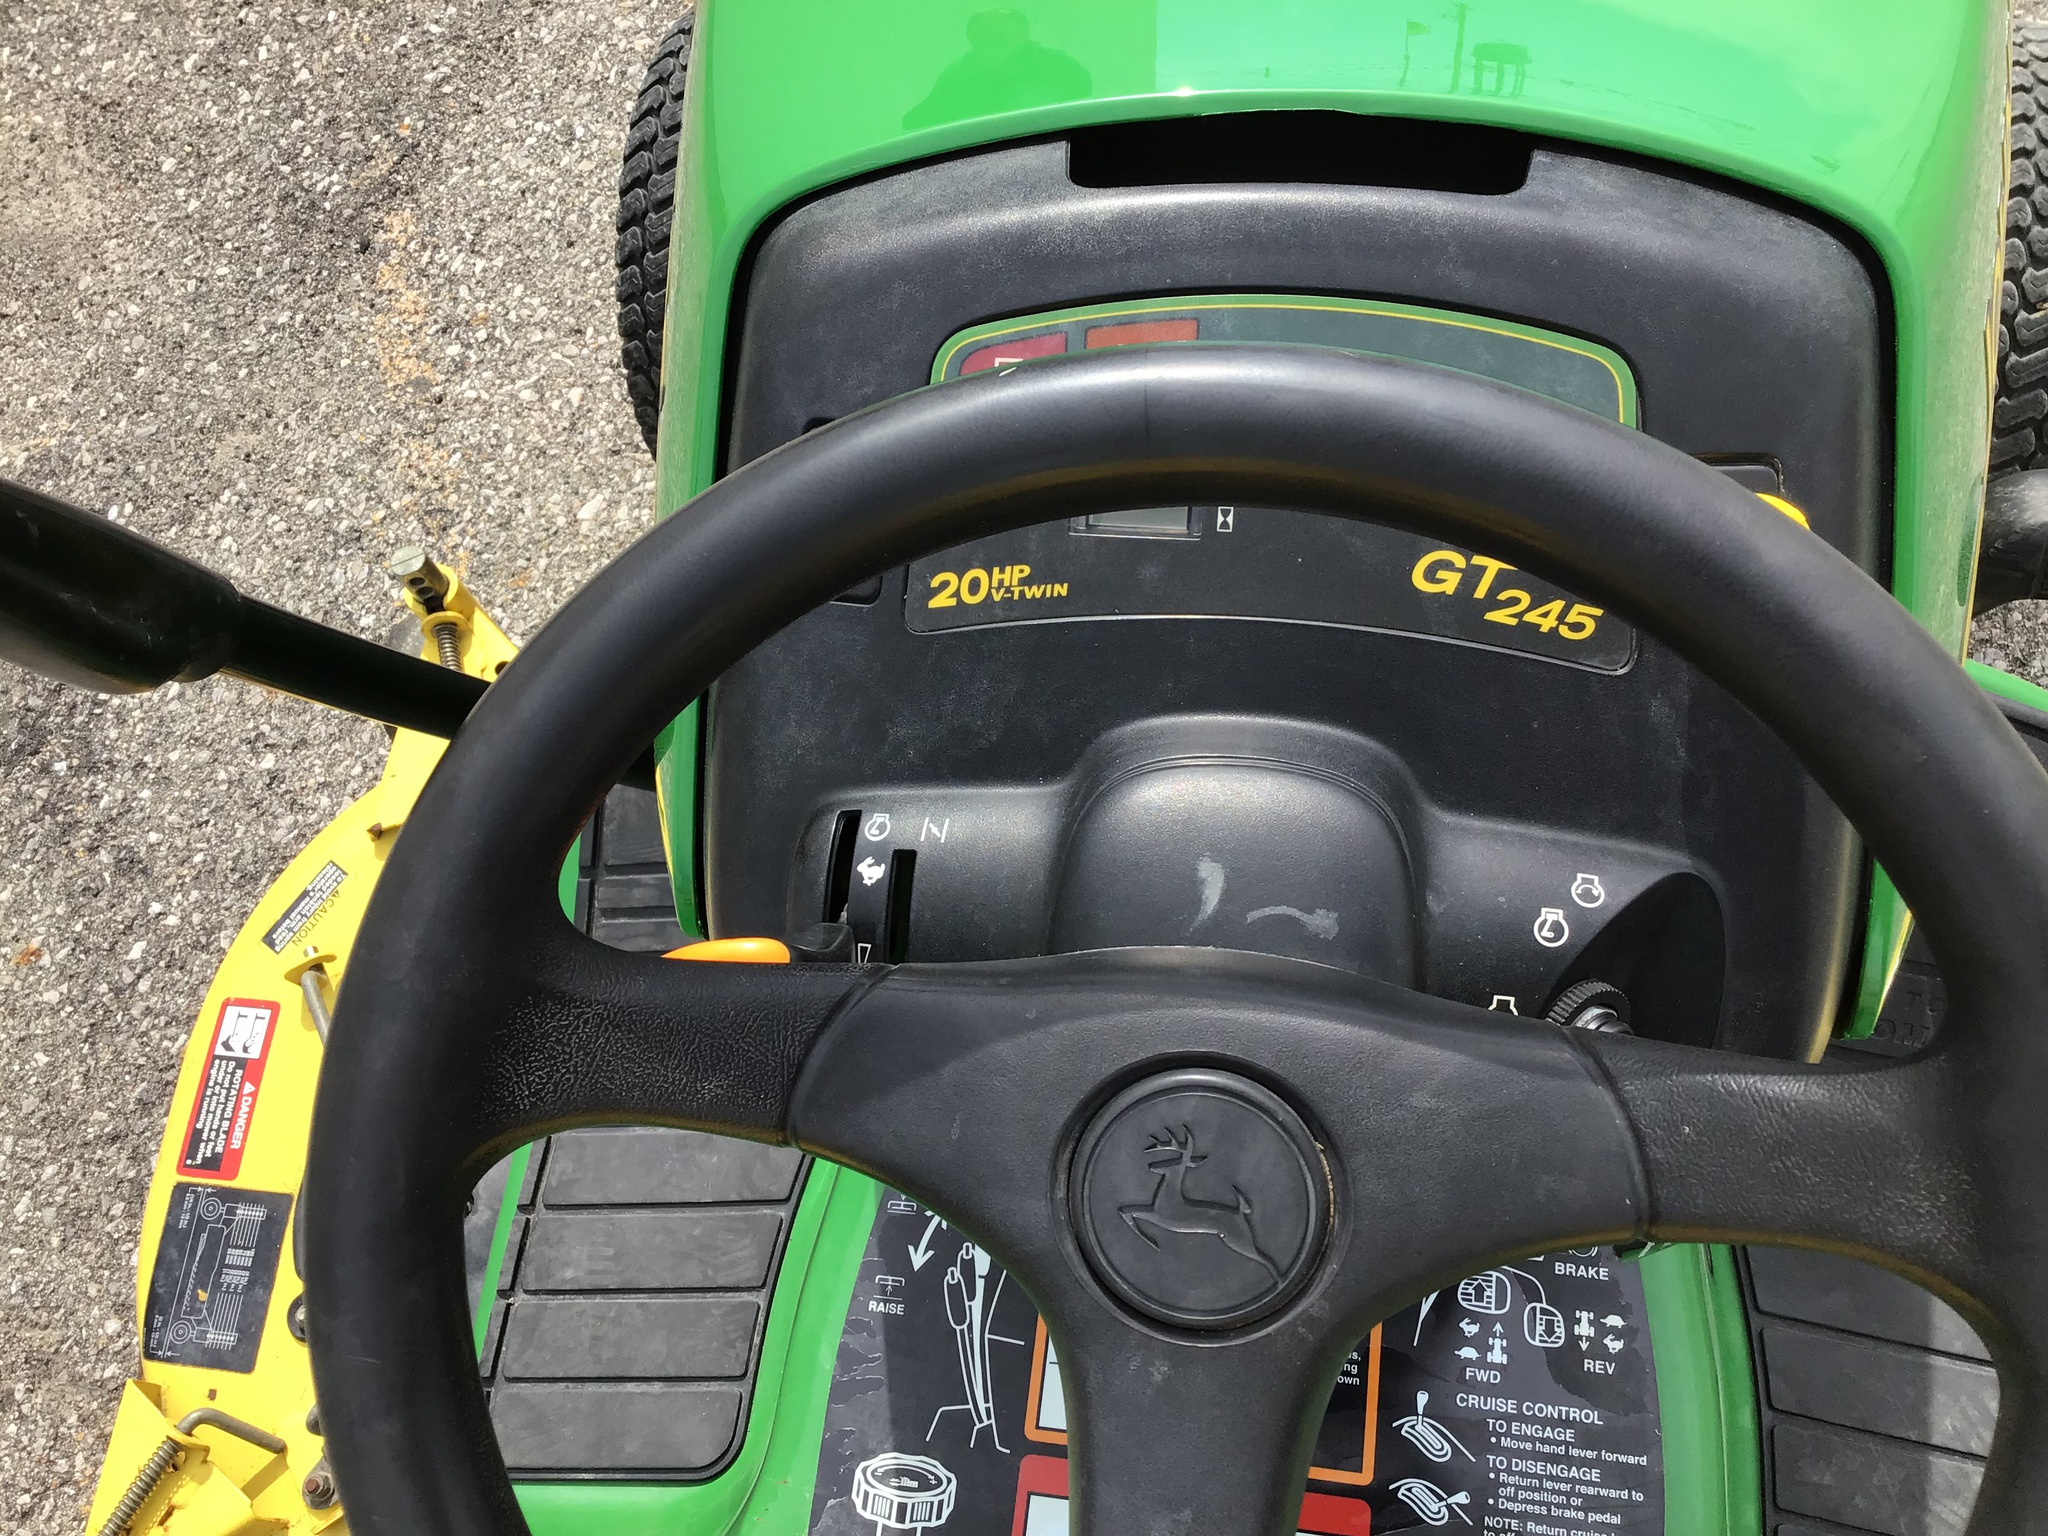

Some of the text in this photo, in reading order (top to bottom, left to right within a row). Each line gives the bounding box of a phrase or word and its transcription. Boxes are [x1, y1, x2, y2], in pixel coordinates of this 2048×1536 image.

[928, 564, 1031, 609] 20 HP
[990, 582, 1069, 602] V-TWIN
[1411, 550, 1604, 640] GT 245
[321, 868, 341, 891] loaded
[335, 872, 346, 882] To
[320, 880, 338, 899] avoid
[289, 895, 311, 919] manual
[300, 889, 323, 915] tension
[271, 918, 290, 939] before
[290, 897, 335, 946] CAUTION
[292, 916, 307, 932] from
[274, 928, 288, 944] read
[274, 930, 294, 952] spring
[206, 1058, 219, 1086] engine
[215, 1060, 228, 1083] under
[213, 1085, 220, 1093] or
[195, 1097, 210, 1129] running
[204, 1060, 235, 1157] Do not put hands or feet
[214, 1068, 243, 1153] ROTATING BLADE
[201, 1113, 213, 1139] mower
[229, 1095, 252, 1149] DANGER
[194, 1142, 206, 1164] when
[1554, 1262, 1609, 1281] BRAKE
[868, 1300, 905, 1315] RAISE
[1465, 1368, 1501, 1384] FWD
[1584, 1359, 1616, 1375] REV
[1456, 1393, 1604, 1425] CRUISE CONTROL
[1487, 1419, 1576, 1442] TO ENGAGE
[1500, 1436, 1647, 1466] Move hand lever forward
[1487, 1455, 1601, 1482] TO DISENGAGE
[1498, 1486, 1583, 1506] off position or
[1499, 1472, 1644, 1501] Return lever rearward to
[1498, 1498, 1621, 1525] Depress brake pedal
[1484, 1516, 1523, 1531] NOTE:
[1526, 1521, 1567, 1536] Return
